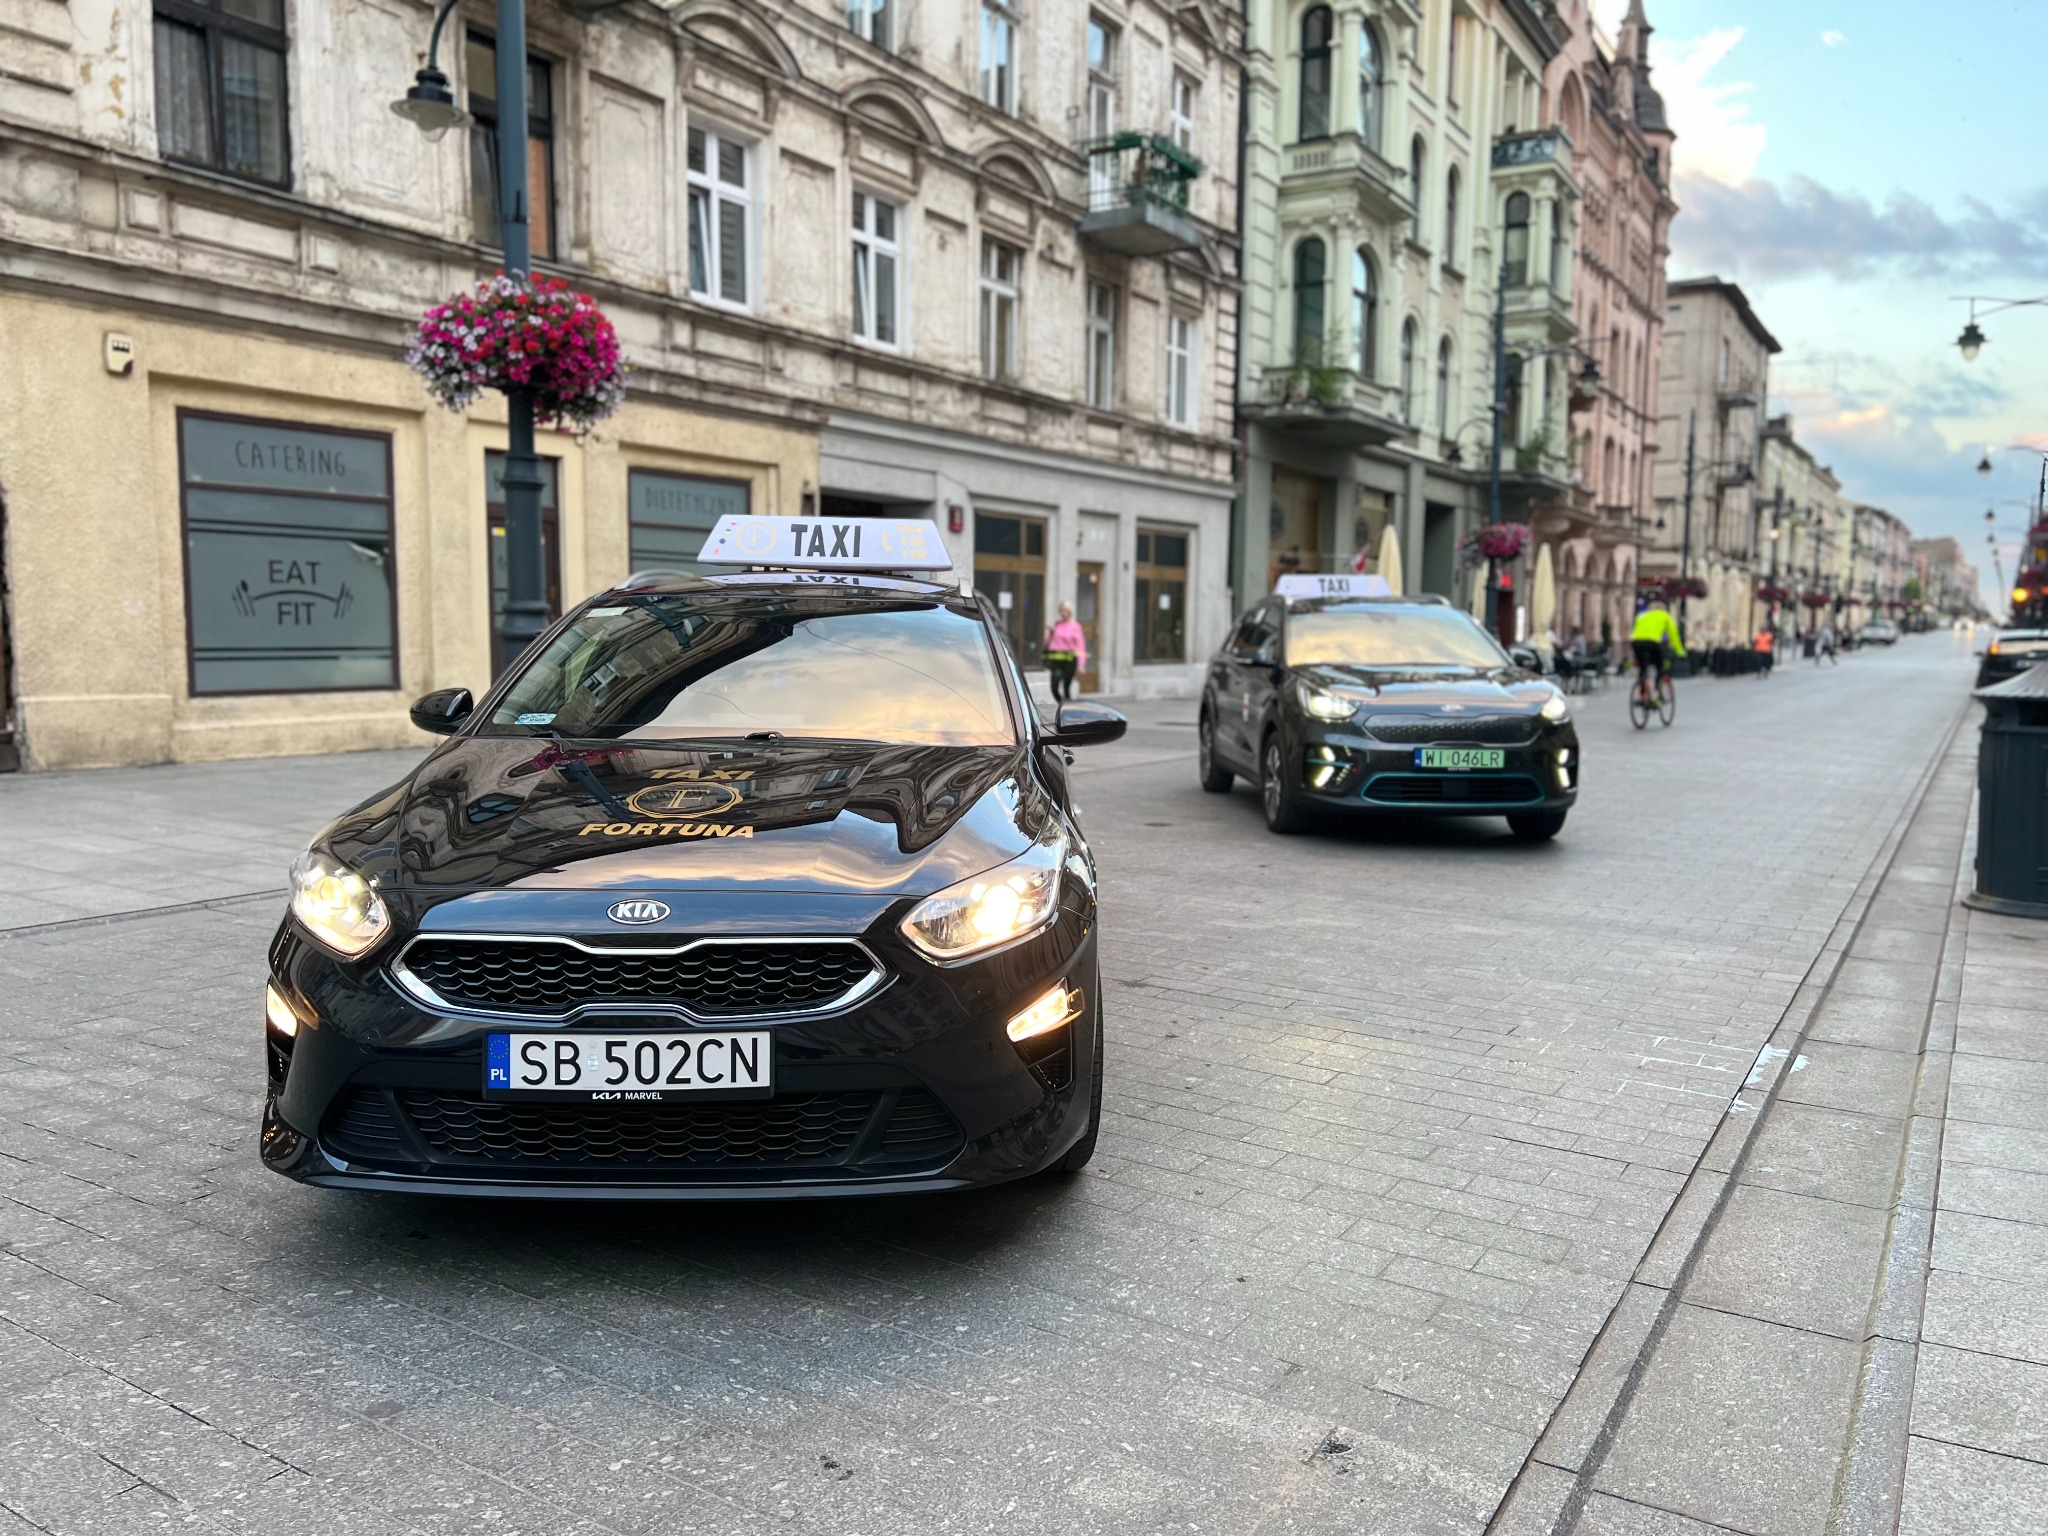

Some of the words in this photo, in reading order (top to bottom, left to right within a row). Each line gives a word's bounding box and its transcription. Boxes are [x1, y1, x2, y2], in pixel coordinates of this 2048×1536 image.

[235, 440, 347, 477] CATERING
[790, 523, 862, 558] TAXI
[267, 559, 321, 585] EAT
[1318, 577, 1350, 593] TAXI
[277, 602, 316, 626] FIT
[1425, 751, 1443, 766] WI
[1451, 751, 1500, 767] 046LR
[649, 769, 757, 780] TAXI
[658, 789, 711, 809] F
[577, 822, 755, 839] FORTUNA
[616, 903, 659, 919] KIA
[520, 1040, 582, 1086] SB
[603, 1037, 759, 1085] 502CN
[490, 1068, 508, 1081] PL
[624, 1091, 663, 1101] MARVEL
